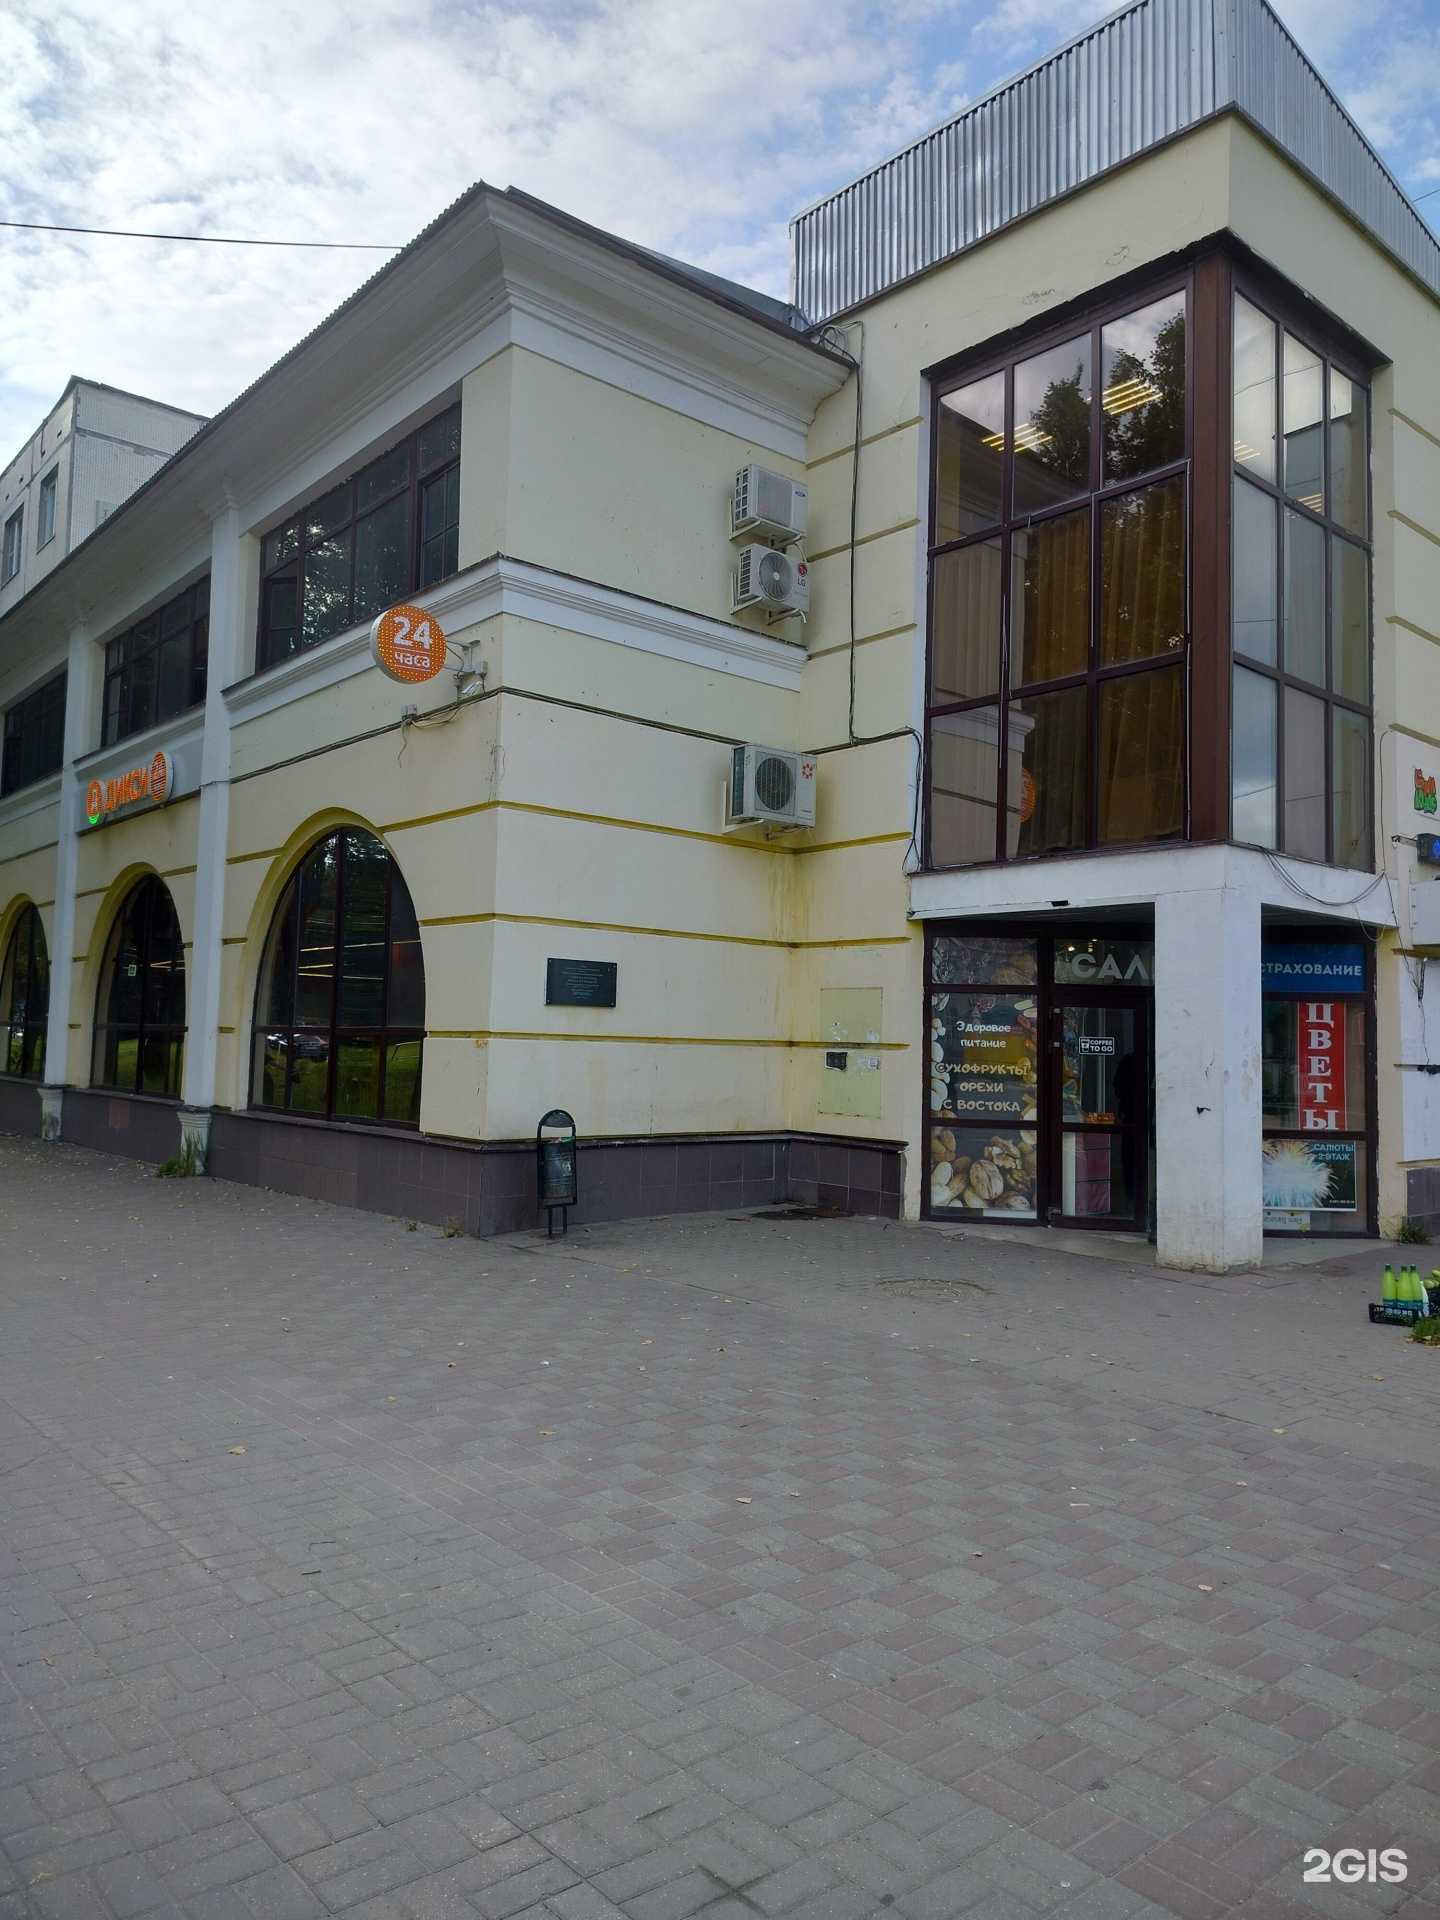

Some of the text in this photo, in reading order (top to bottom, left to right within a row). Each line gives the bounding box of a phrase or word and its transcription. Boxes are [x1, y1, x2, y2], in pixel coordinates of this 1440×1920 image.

[393, 615, 432, 650] 24
[394, 651, 431, 668] часа
[1072, 953, 1155, 980] САЛ
[956, 1021, 1012, 1033] Здоровое
[960, 1039, 1007, 1049] питание
[936, 1063, 1029, 1076] СУХОФРУКТЫ
[1303, 1002, 1339, 1131] ЦВЕТЫ
[959, 1082, 1004, 1093] ОРЕХИ
[957, 1100, 1021, 1112] ВОСТОКА
[1313, 1143, 1354, 1152] САЛЮТЫ
